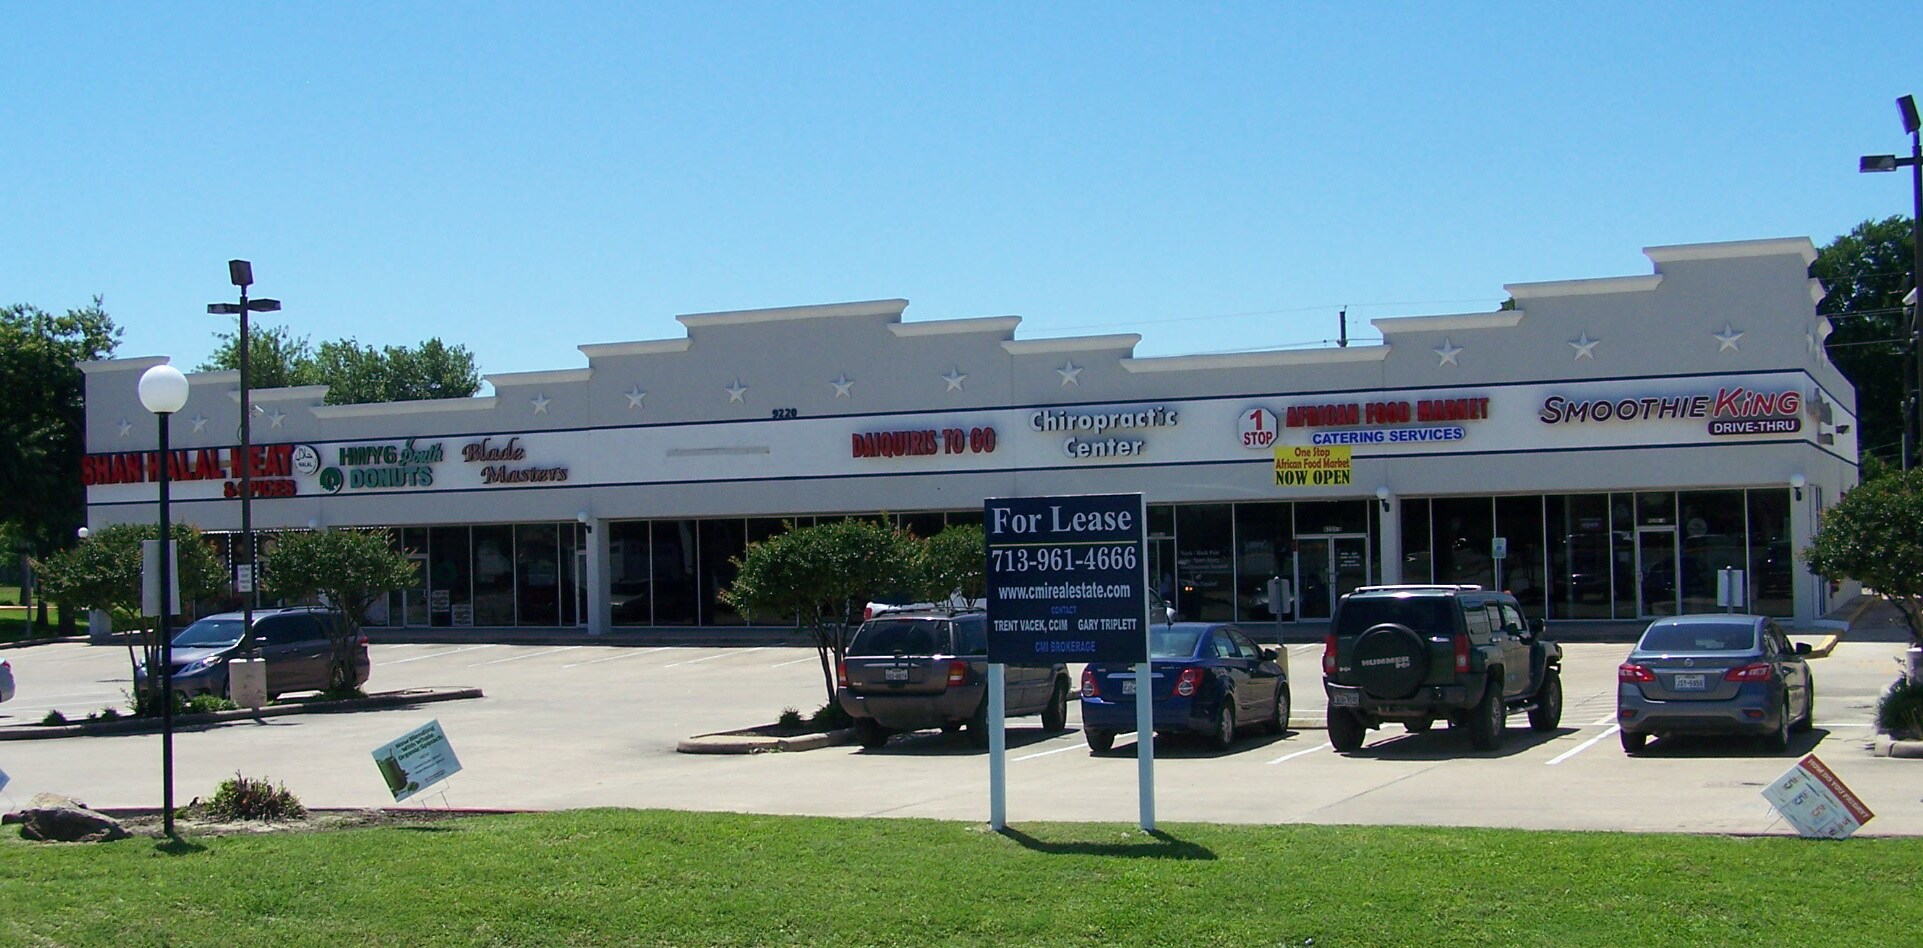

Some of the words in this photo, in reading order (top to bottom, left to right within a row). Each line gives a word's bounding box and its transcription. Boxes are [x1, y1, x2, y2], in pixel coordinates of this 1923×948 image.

[772, 408, 798, 419] 9220
[1286, 403, 1359, 427] AFRICAN
[1366, 401, 1411, 424] FOOD
[1417, 398, 1489, 421] MARKET
[1540, 396, 1709, 424] SMOOTHIE
[1030, 406, 1178, 434] Chiropractic
[1250, 409, 1263, 430] 1
[1714, 420, 1795, 433] DRIVE-THRU
[852, 430, 938, 458] DAIQUIRIS
[942, 428, 965, 454] TO
[970, 427, 996, 453] GO
[1244, 431, 1273, 446] STOP
[1312, 431, 1385, 444] CATERING
[1389, 428, 1463, 442] SERVICES
[461, 437, 525, 463] Blade
[1063, 437, 1144, 458] Center
[1294, 447, 1311, 457] One
[1313, 446, 1330, 458] Stop
[80, 454, 144, 485] SHAN
[1276, 458, 1302, 469] African
[1303, 458, 1321, 469] Food
[1323, 458, 1350, 469] Market
[350, 466, 434, 488] DONUTS
[480, 465, 569, 485] Masters
[1276, 470, 1308, 485] NOW
[1313, 470, 1350, 485] OPEN
[992, 507, 1042, 534] For
[1050, 505, 1132, 532] Lease
[992, 546, 1136, 572] 713-961-4666
[999, 582, 1131, 599] www.cmirealestate.com
[1051, 606, 1077, 614] CONTACT
[994, 620, 1018, 631] TRENT
[1020, 619, 1047, 633] VACEK,
[1048, 619, 1068, 631] CCIM
[1078, 619, 1098, 631] GARY
[1100, 618, 1137, 630] TRIPLETT
[1050, 641, 1096, 652] BROKERAGE
[1361, 656, 1410, 667] HUMMER
